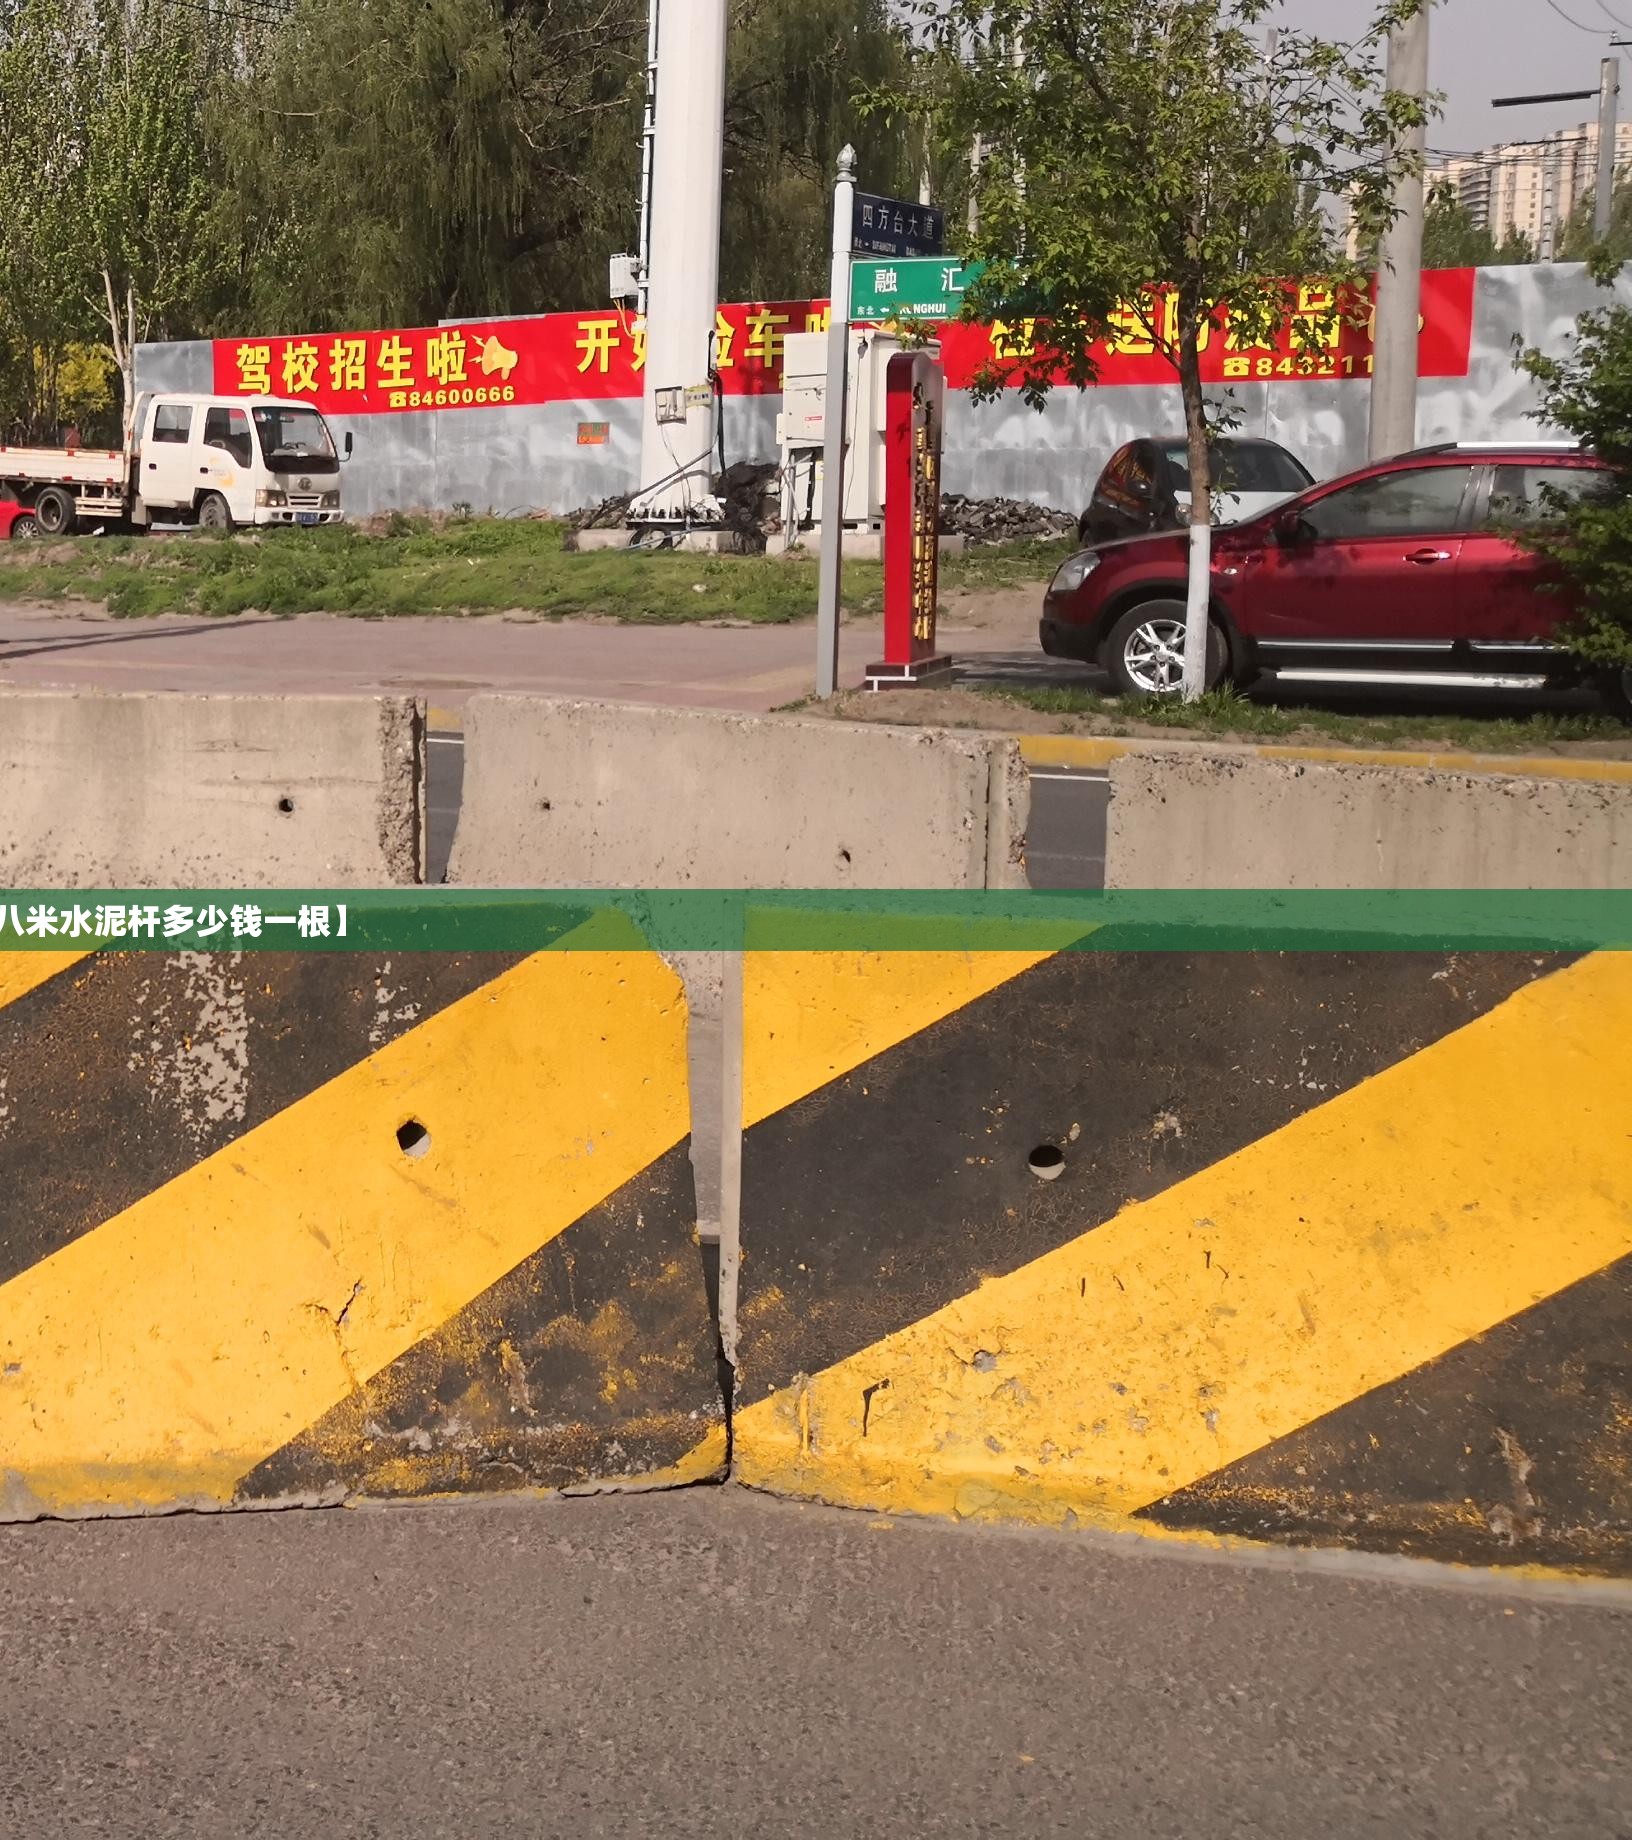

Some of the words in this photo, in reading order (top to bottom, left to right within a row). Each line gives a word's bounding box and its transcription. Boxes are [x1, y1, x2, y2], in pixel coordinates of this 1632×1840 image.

[861, 203, 935, 240] 四方台大道
[874, 266, 966, 294] 融汇
[235, 330, 468, 395] 驾校招生啦
[409, 385, 516, 407] 84600666
